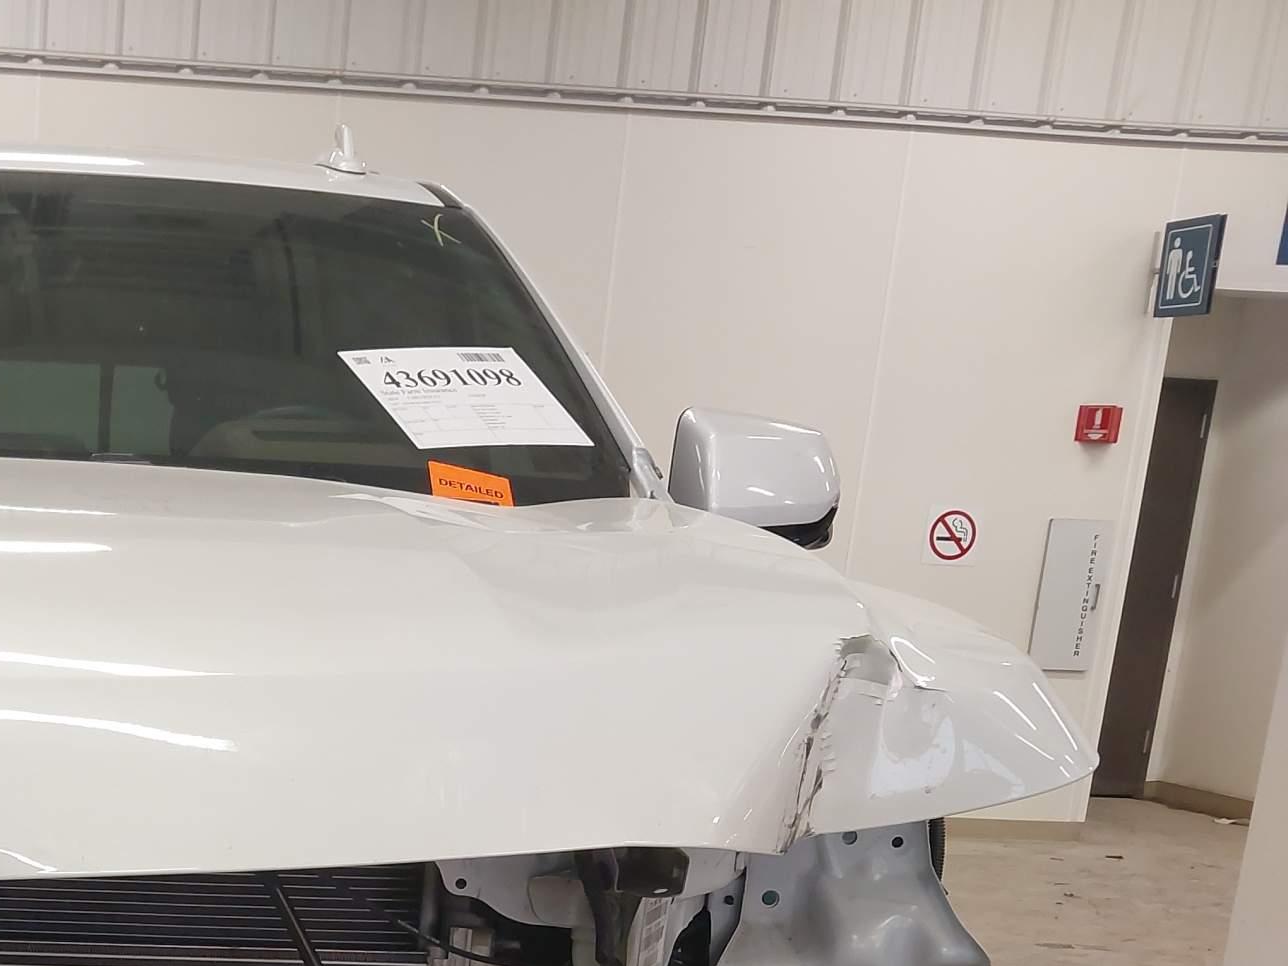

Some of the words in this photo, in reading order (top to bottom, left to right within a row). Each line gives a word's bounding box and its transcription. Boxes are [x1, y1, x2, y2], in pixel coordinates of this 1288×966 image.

[383, 368, 522, 388] 43691098
[438, 478, 504, 499] DETAILED
[1089, 534, 1100, 565] FIRE
[1073, 567, 1094, 657] EXTINGUISHER
